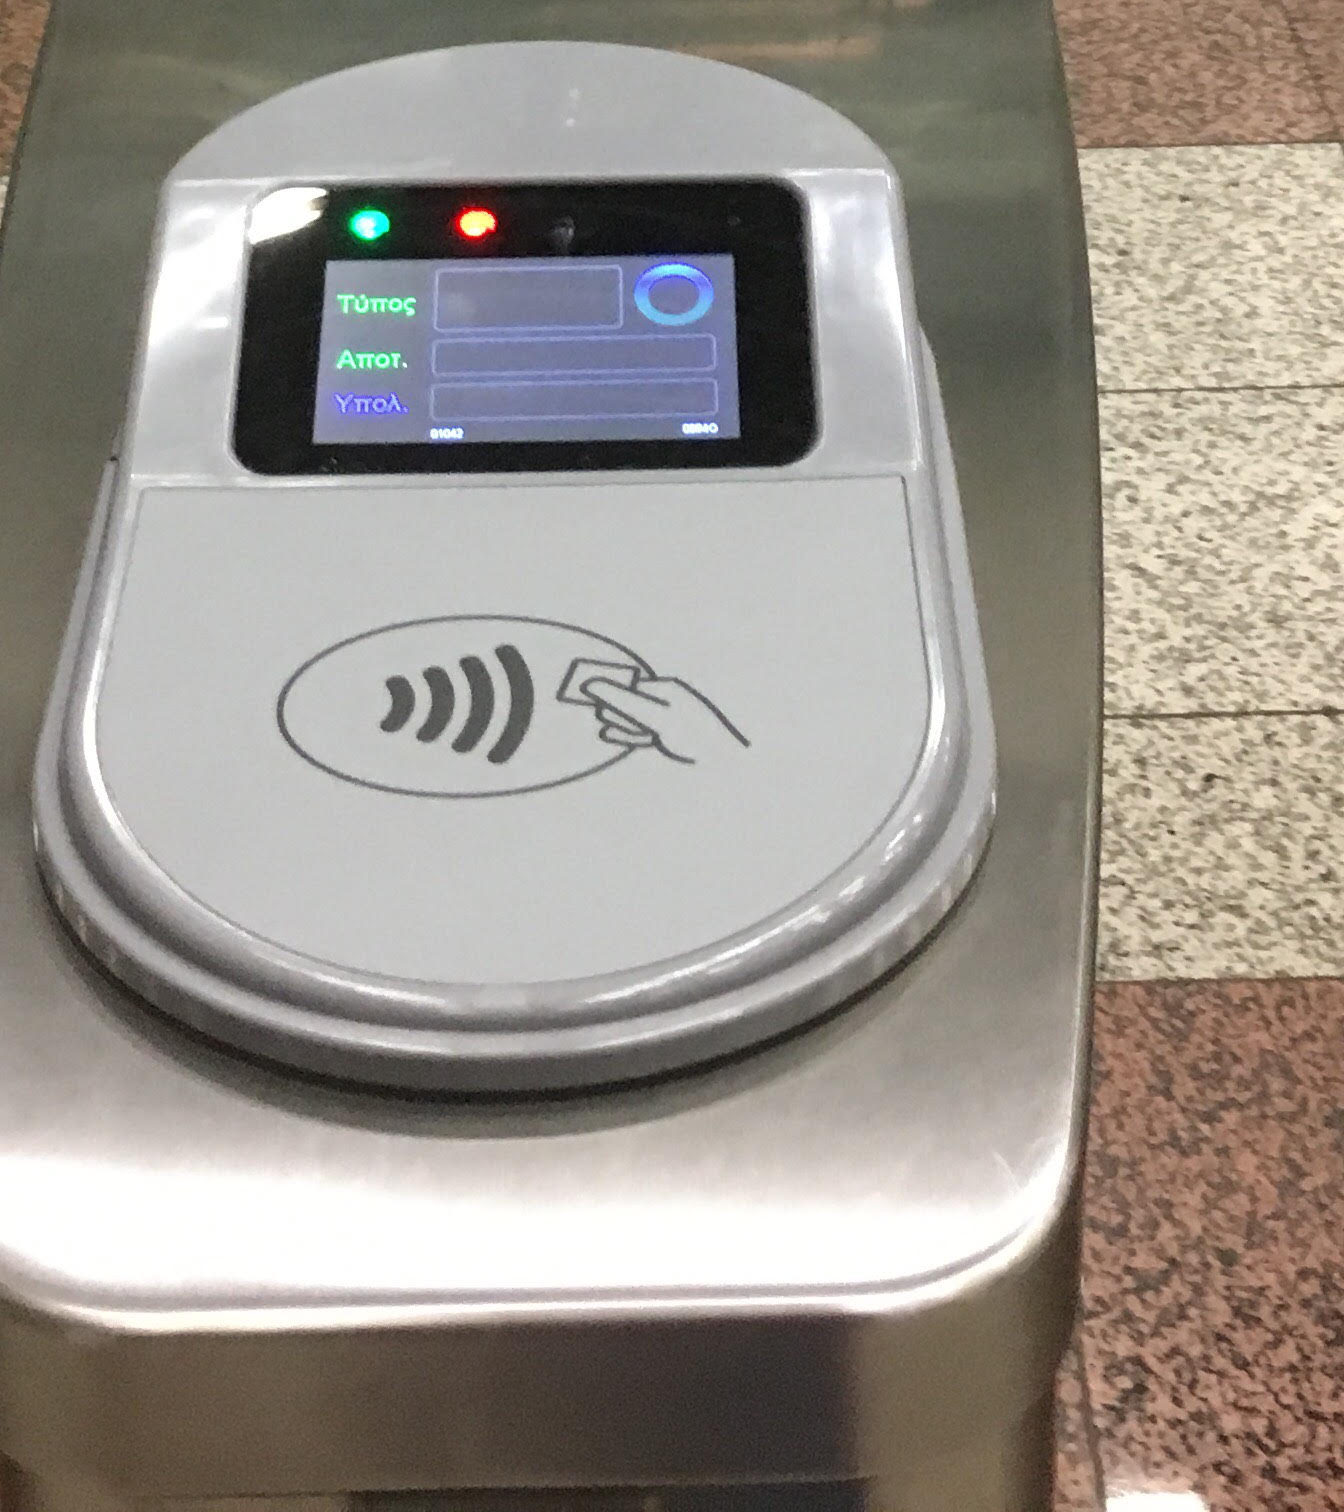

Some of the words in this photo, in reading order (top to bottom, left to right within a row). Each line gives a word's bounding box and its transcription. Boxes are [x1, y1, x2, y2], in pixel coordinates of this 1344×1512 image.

[336, 293, 417, 316] Τύπος
[335, 348, 408, 369] Αποτ.
[334, 392, 409, 415] Υπολ.
